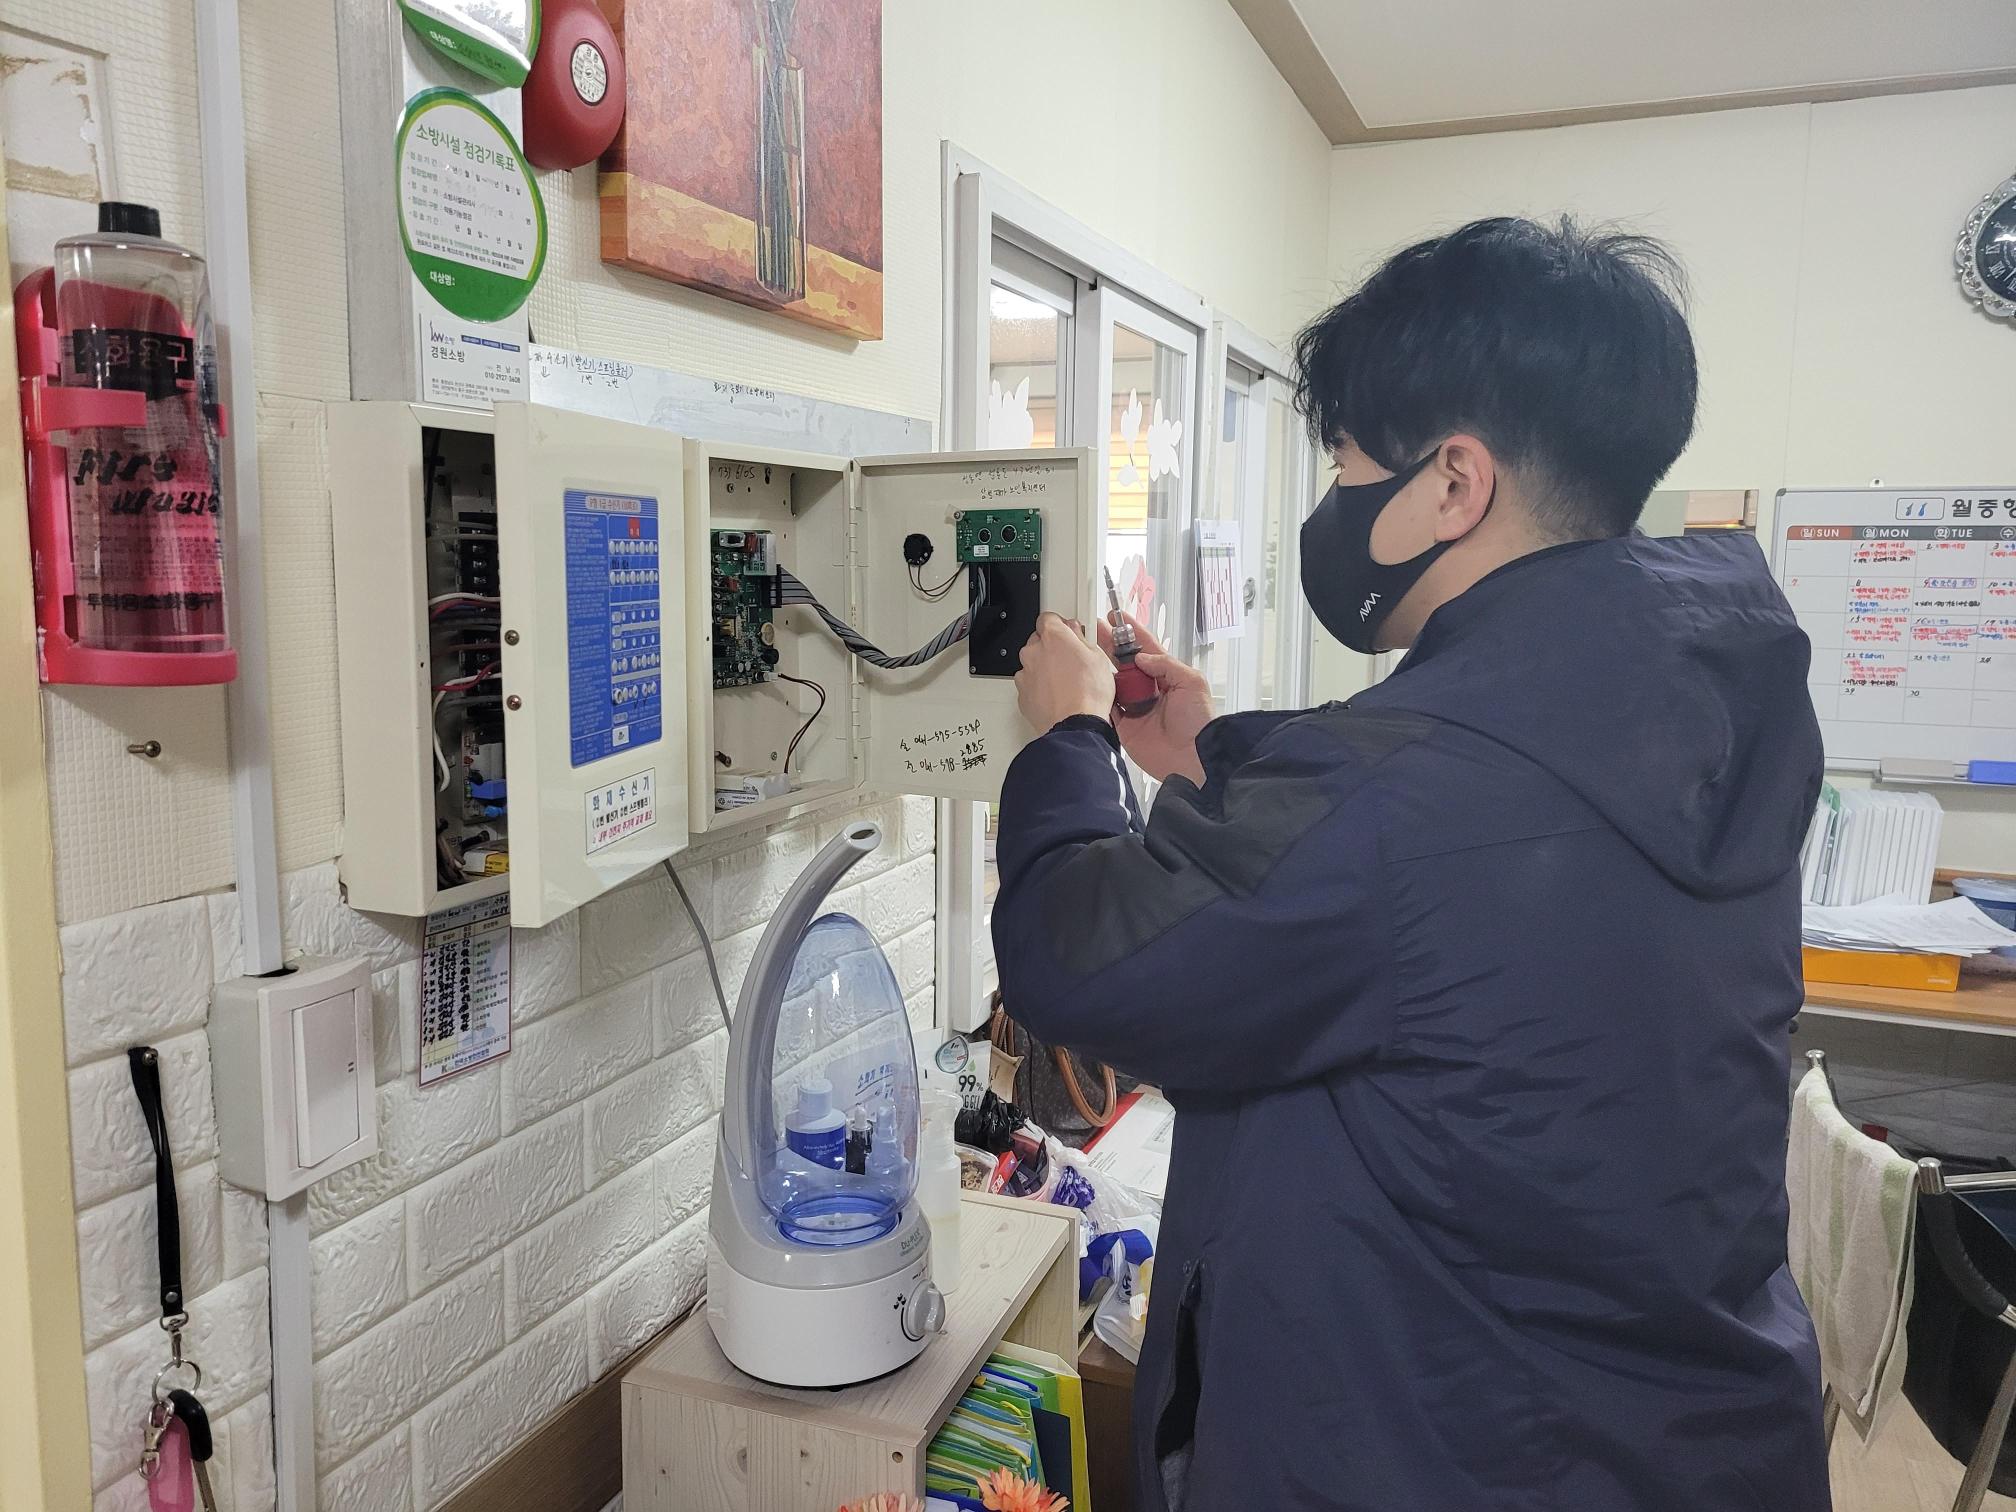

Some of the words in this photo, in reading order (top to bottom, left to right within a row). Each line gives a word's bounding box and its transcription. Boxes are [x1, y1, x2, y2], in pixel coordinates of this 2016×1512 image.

[416, 124, 461, 154] 소방시설
[464, 140, 517, 173] 점검기록표
[430, 271, 456, 286] 대상명:
[431, 346, 466, 363] 경원소방
[1817, 528, 1840, 538] SUN
[1879, 528, 1910, 538] MON
[1951, 528, 1973, 538] TUE
[959, 738, 985, 757] 2885
[958, 1074, 984, 1093] 99%
